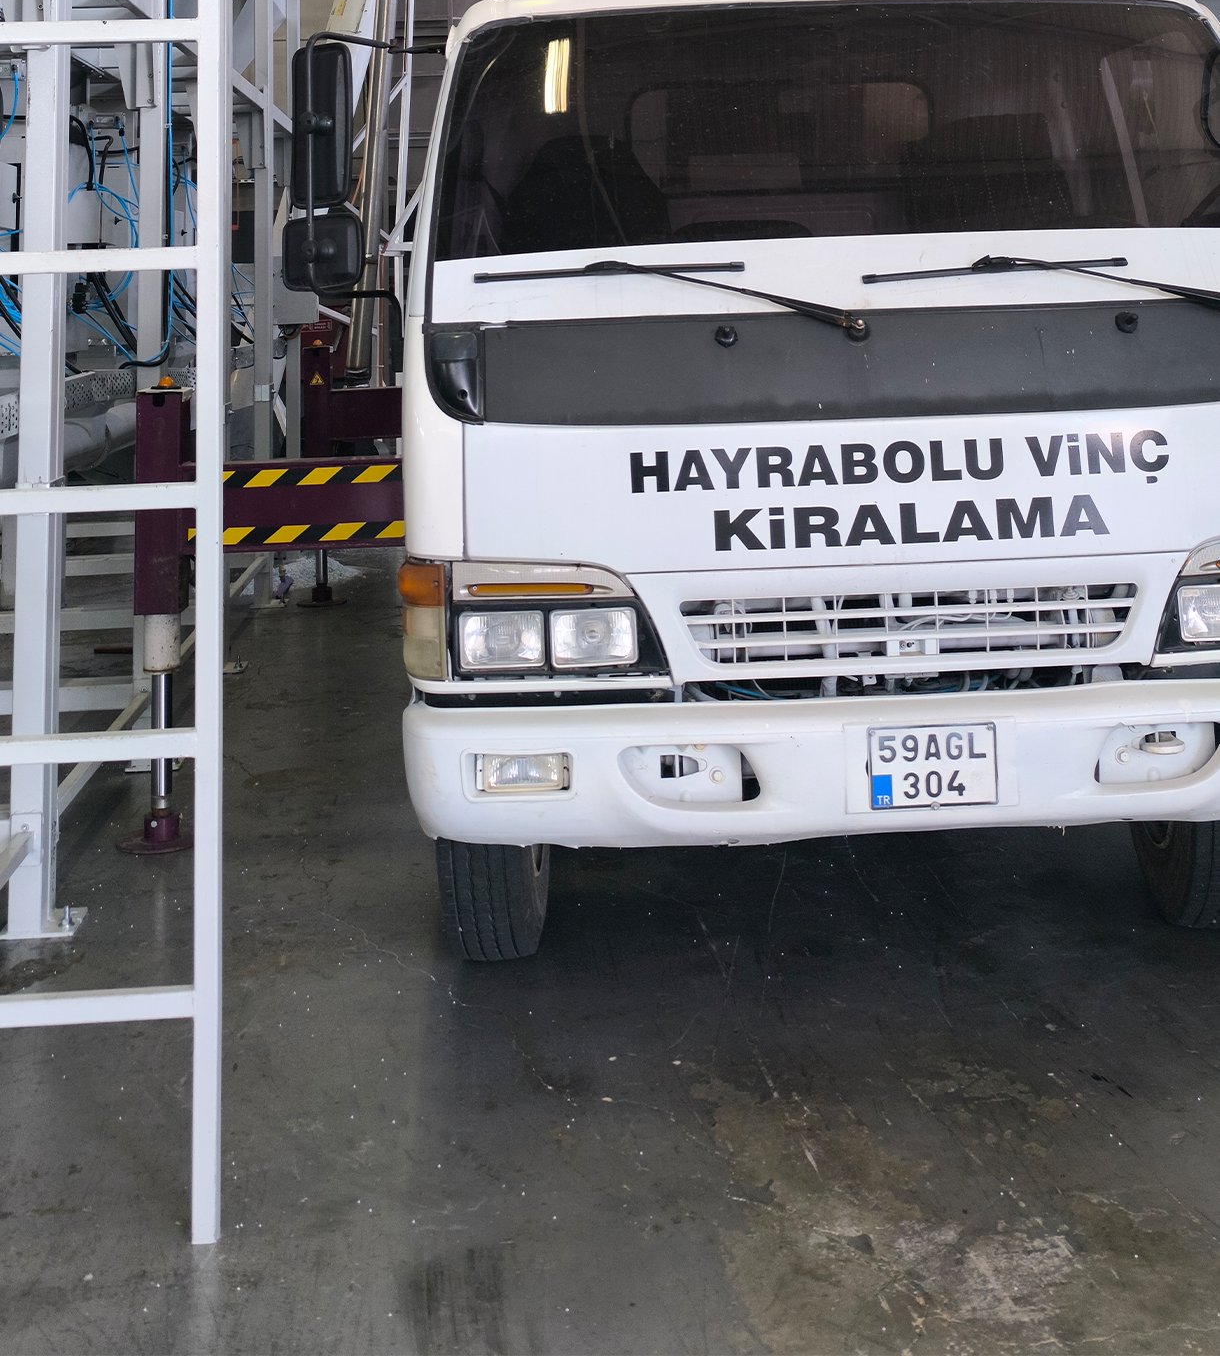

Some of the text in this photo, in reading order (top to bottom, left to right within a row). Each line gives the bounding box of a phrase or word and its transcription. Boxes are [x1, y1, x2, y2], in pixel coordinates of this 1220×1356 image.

[630, 437, 1004, 493] HAYRABOLU
[878, 732, 986, 763] 59AGL
[903, 770, 966, 799] 304
[876, 795, 891, 805] TR
